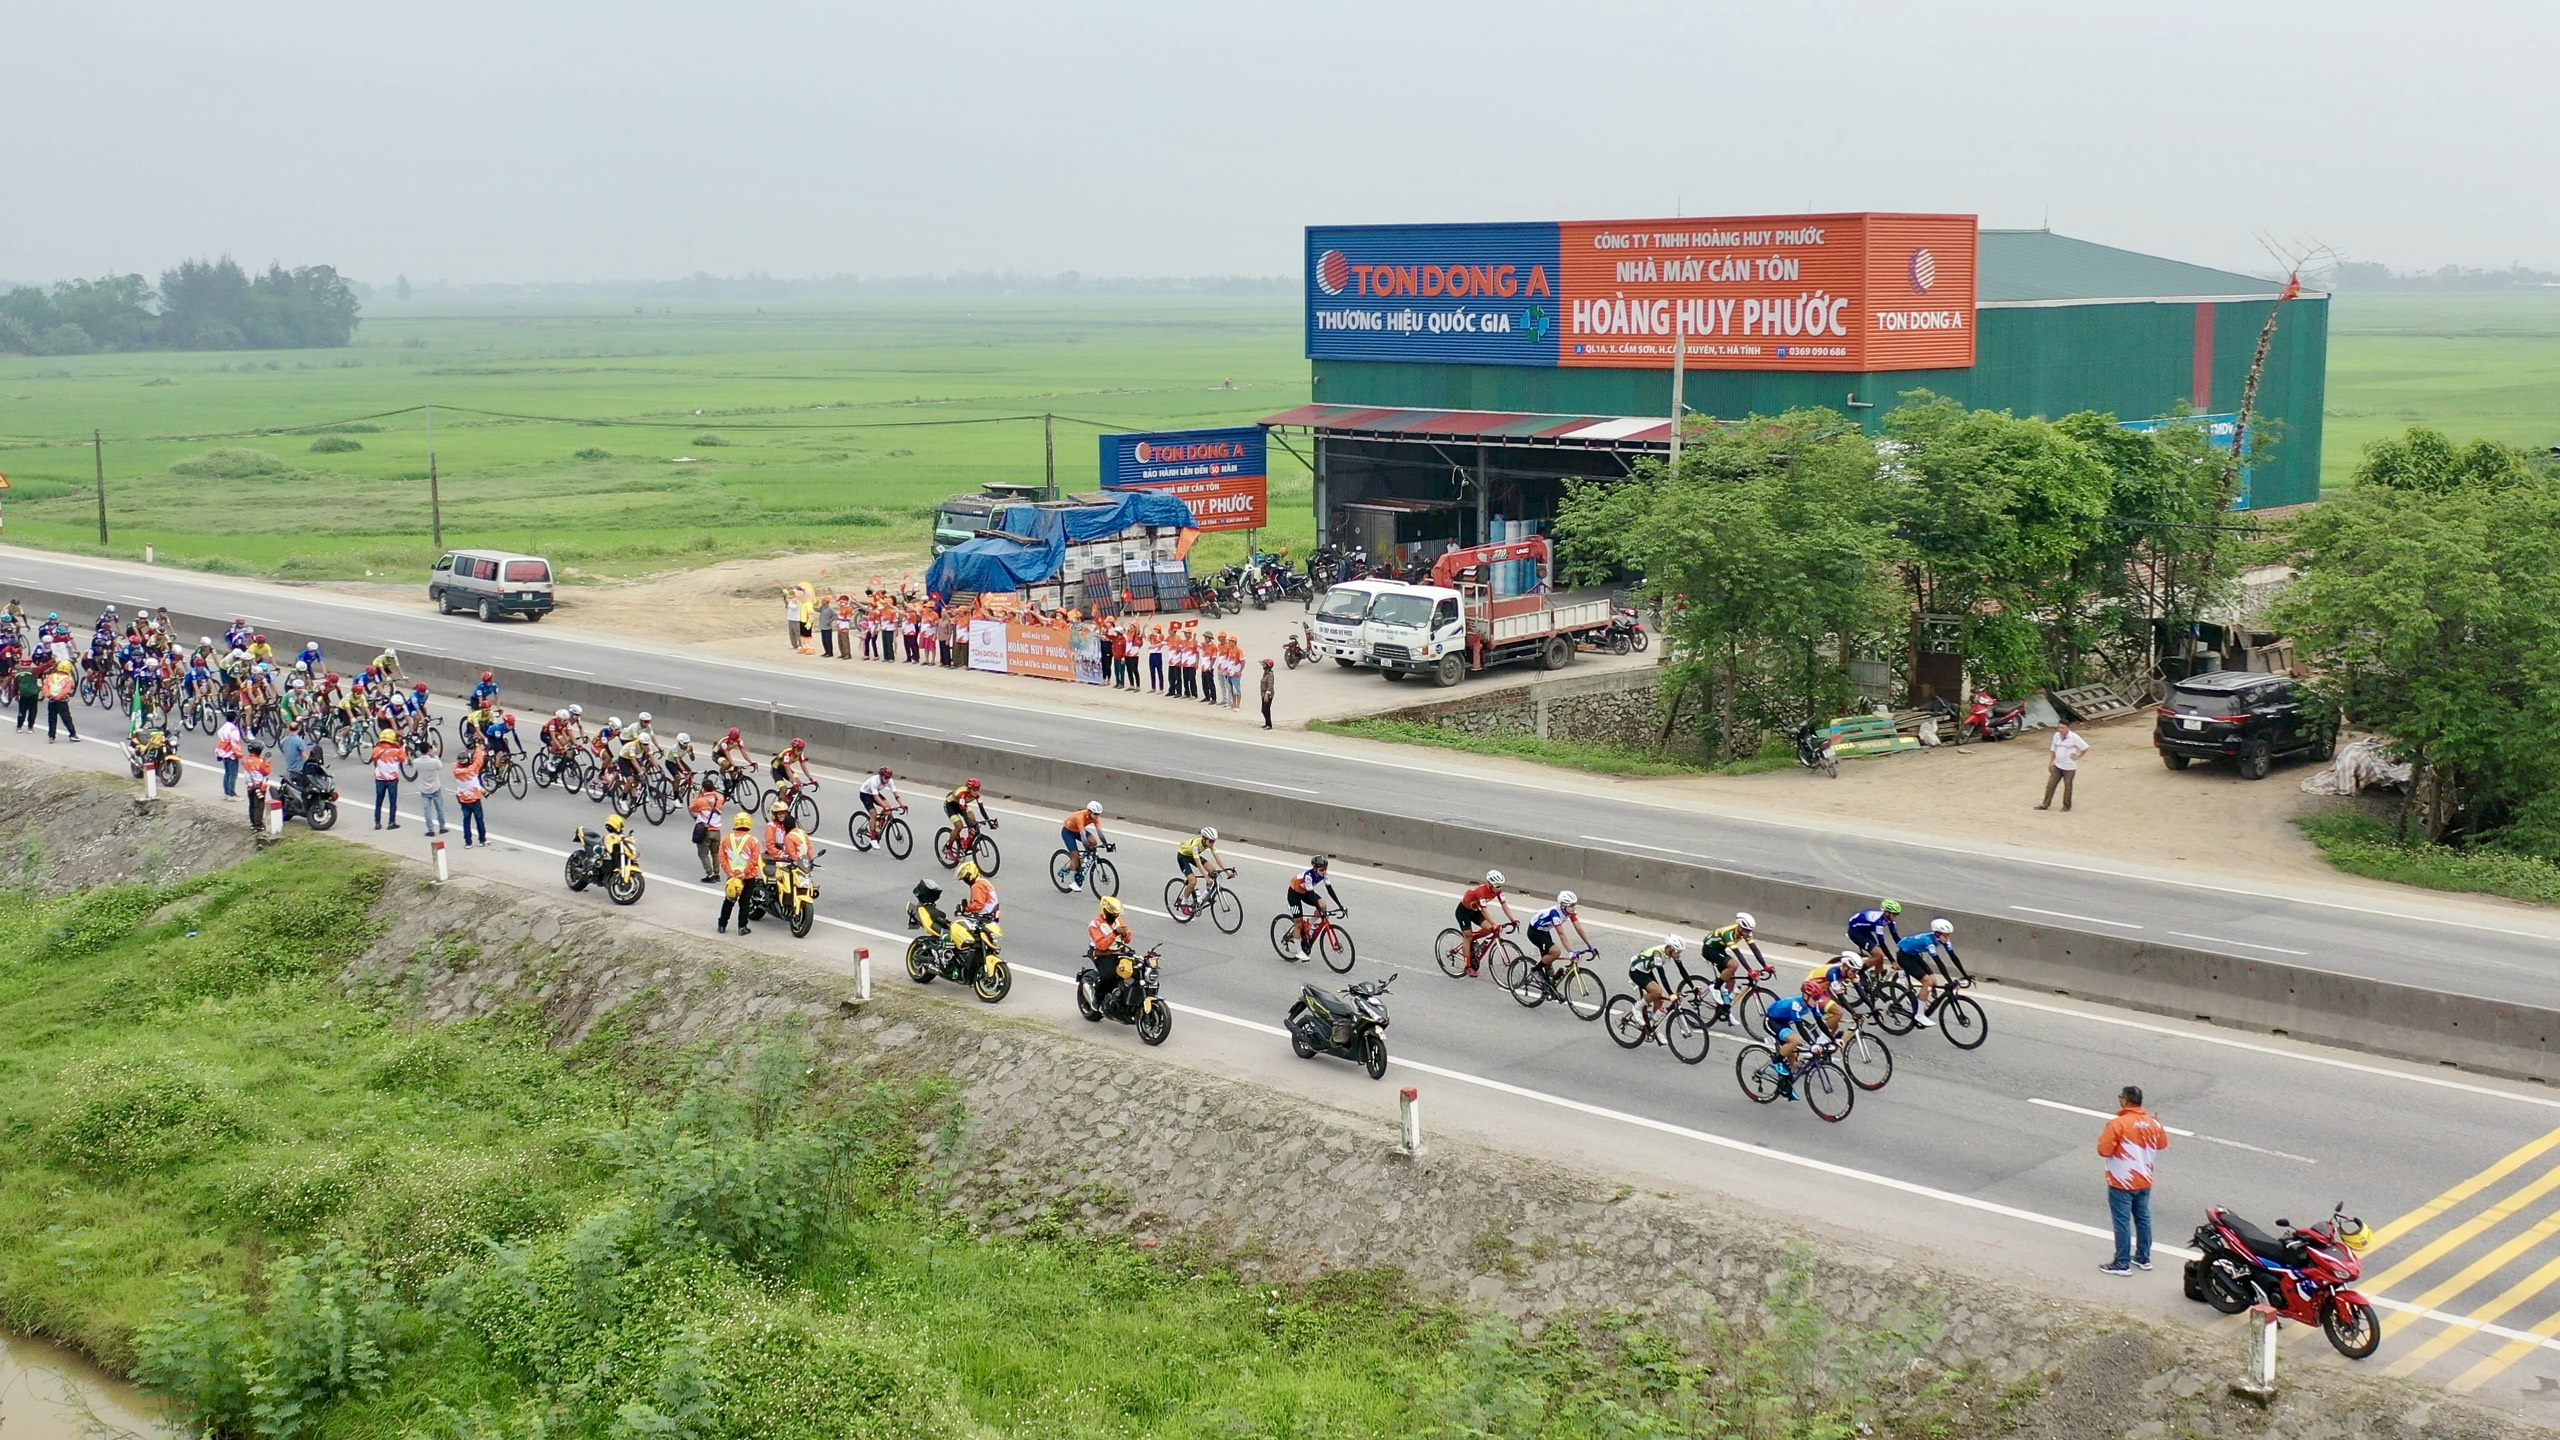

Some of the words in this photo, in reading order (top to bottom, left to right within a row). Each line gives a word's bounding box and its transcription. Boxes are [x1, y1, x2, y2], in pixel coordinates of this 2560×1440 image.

[1594, 232, 1630, 249] CÔNG
[1632, 234, 1650, 248] TY
[1653, 233, 1688, 248] TNHH
[1692, 228, 1740, 247] HOÀNG
[1743, 231, 1771, 246] HUY
[1775, 226, 1825, 245] PHƯỚC
[1616, 256, 1657, 283] NHÀ
[1664, 255, 1705, 282] MÁY
[1708, 255, 1750, 282] CÁN
[1756, 254, 1799, 281] TÔN
[1352, 264, 1418, 297] TON
[1423, 264, 1517, 298] DONG
[1525, 264, 1551, 297] A
[1316, 308, 1382, 331] THƯƠNG
[1387, 308, 1423, 336] HIỆU
[1428, 306, 1474, 334] QUỐC
[1481, 313, 1511, 332] GIA
[1572, 292, 1670, 335] HOÀNG
[1676, 298, 1736, 335] HUY
[1743, 290, 1848, 336] PHƯỚC
[1876, 311, 1907, 330] TON
[1910, 311, 1950, 330] DONG
[1952, 311, 1963, 329] A
[1585, 345, 1609, 354] QL1A,
[1727, 344, 1739, 355] HÀ
[1789, 347, 1811, 356] 0369
[1811, 347, 1828, 356] 090
[1829, 347, 1847, 356] 686
[1152, 446, 1185, 462] TON
[1187, 443, 1230, 460] DONG
[1233, 443, 1246, 457] A
[1209, 492, 1254, 514] PHƯỚC
